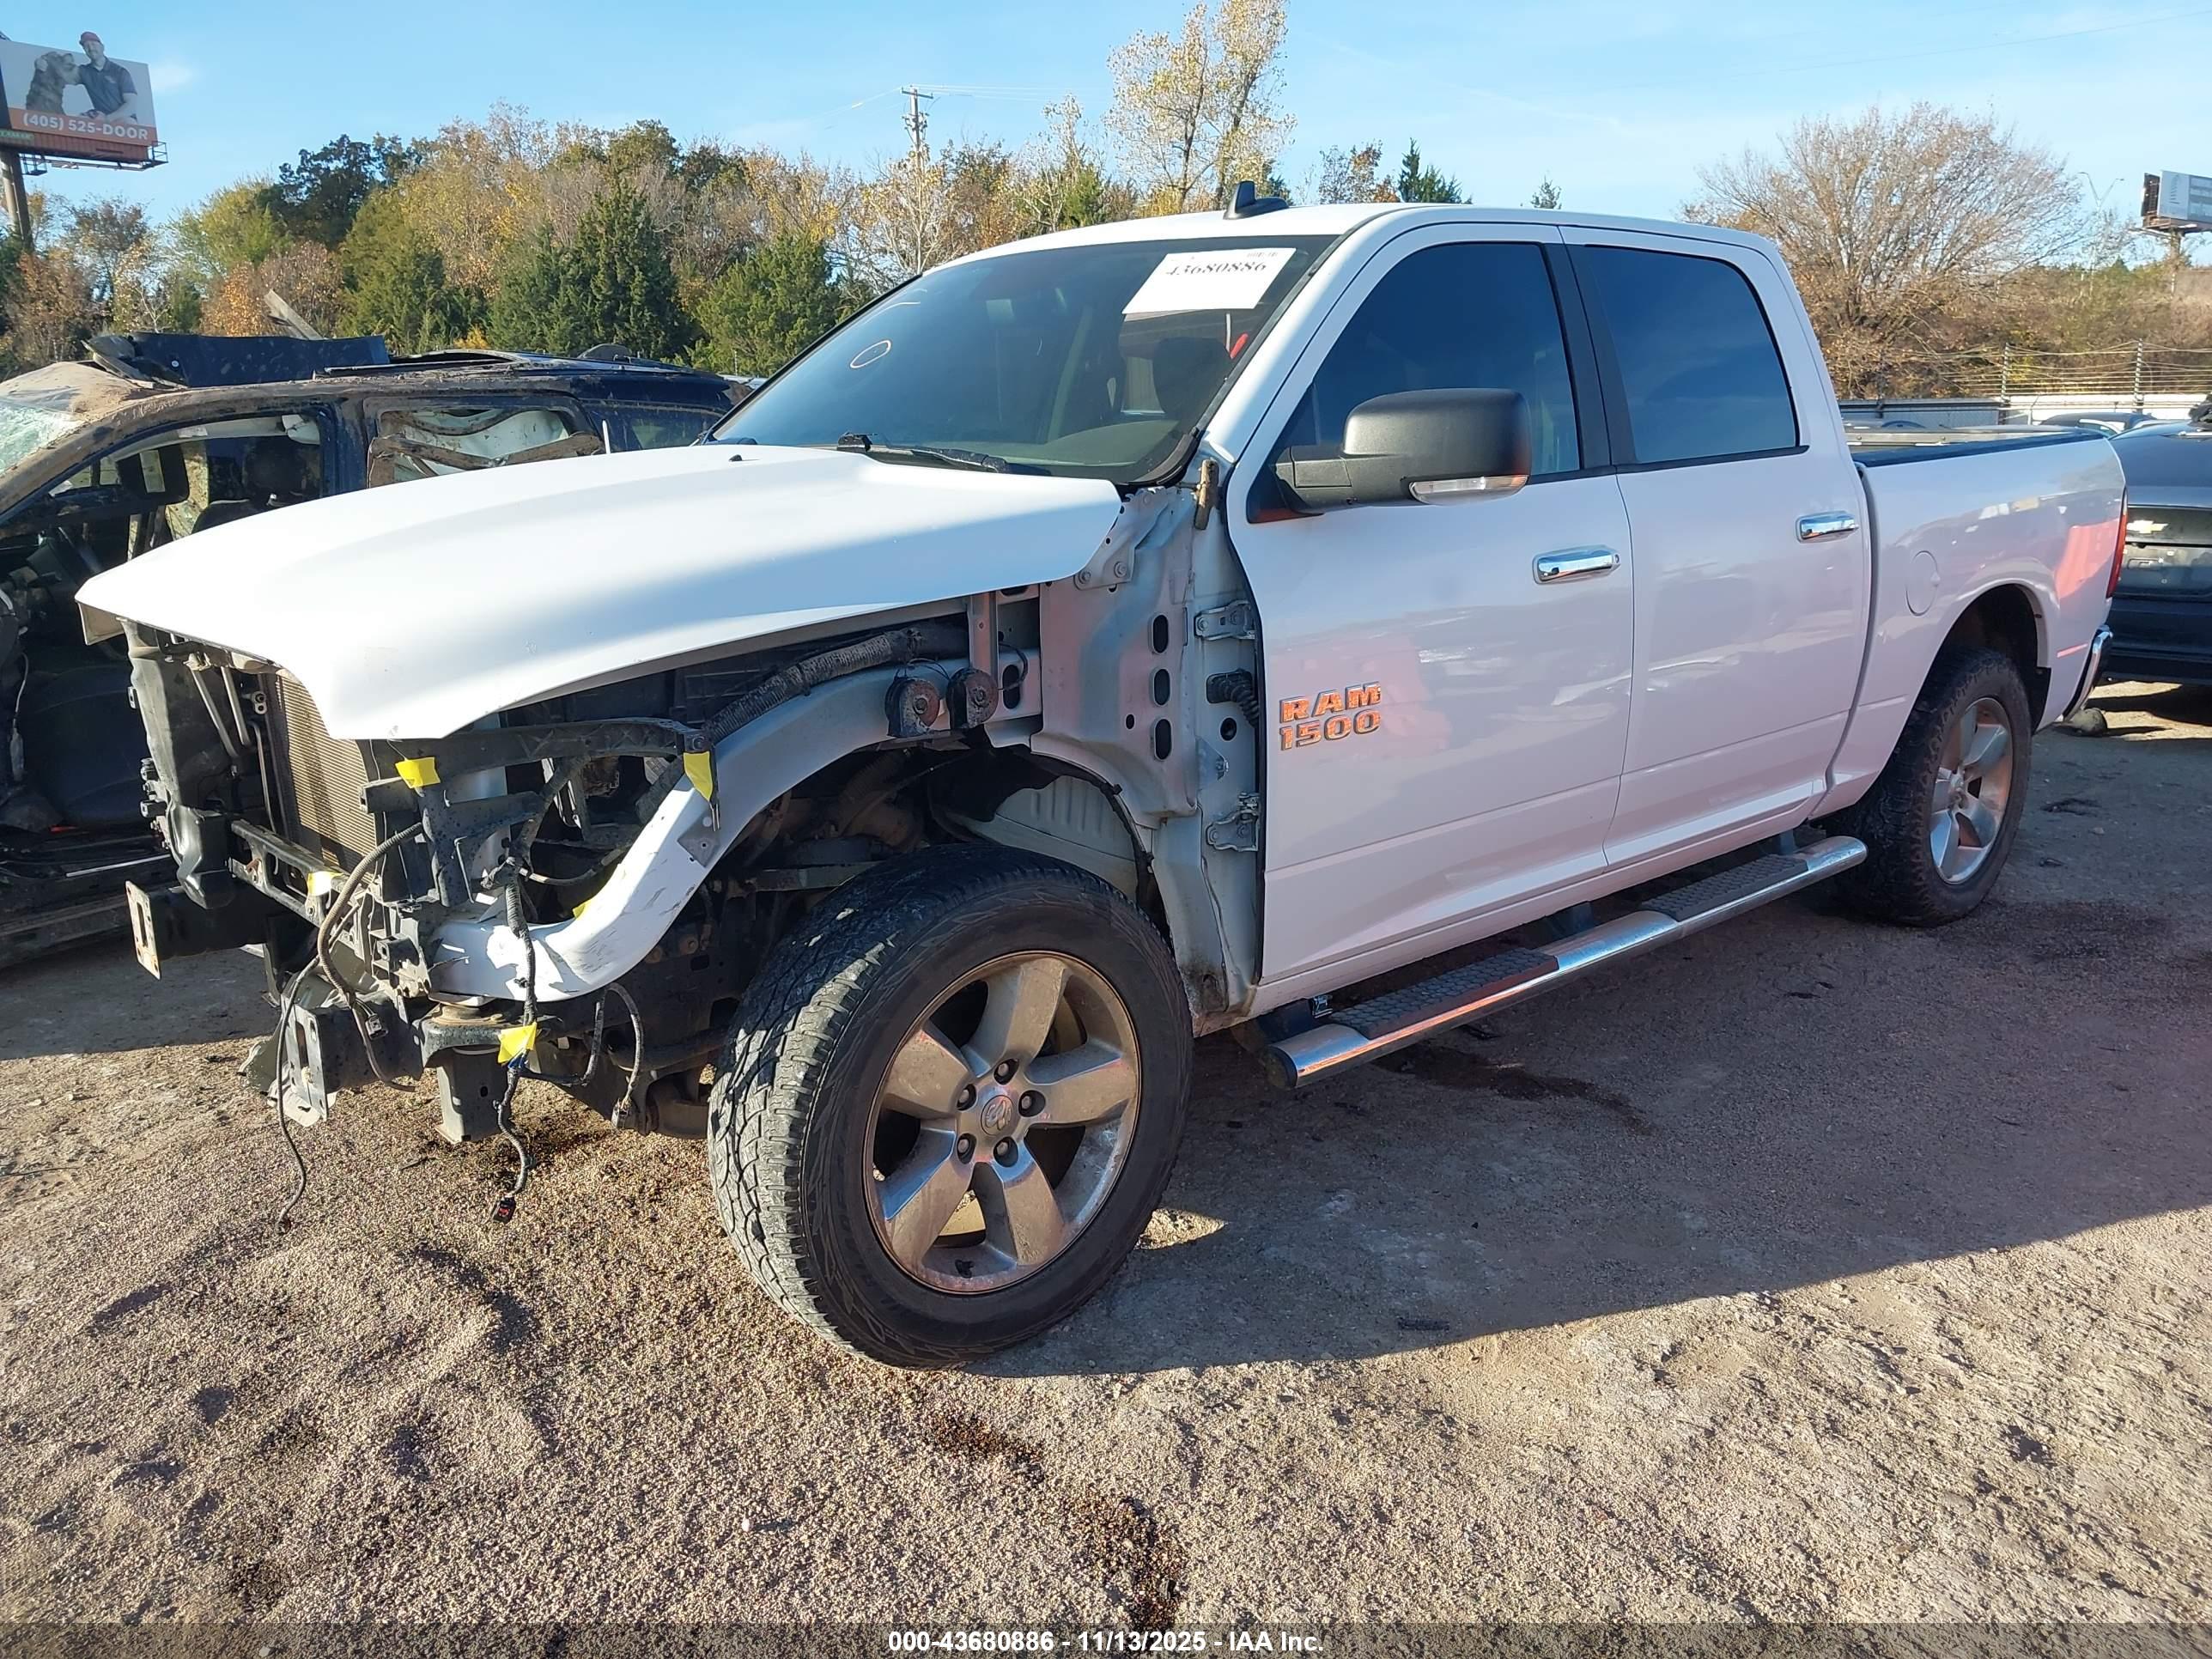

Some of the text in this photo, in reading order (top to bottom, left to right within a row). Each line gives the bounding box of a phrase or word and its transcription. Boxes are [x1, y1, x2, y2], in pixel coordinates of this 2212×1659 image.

[23, 112, 149, 141] (405) 525-DOOR
[1279, 681, 1382, 724] RAM
[1279, 708, 1382, 751] 1500
